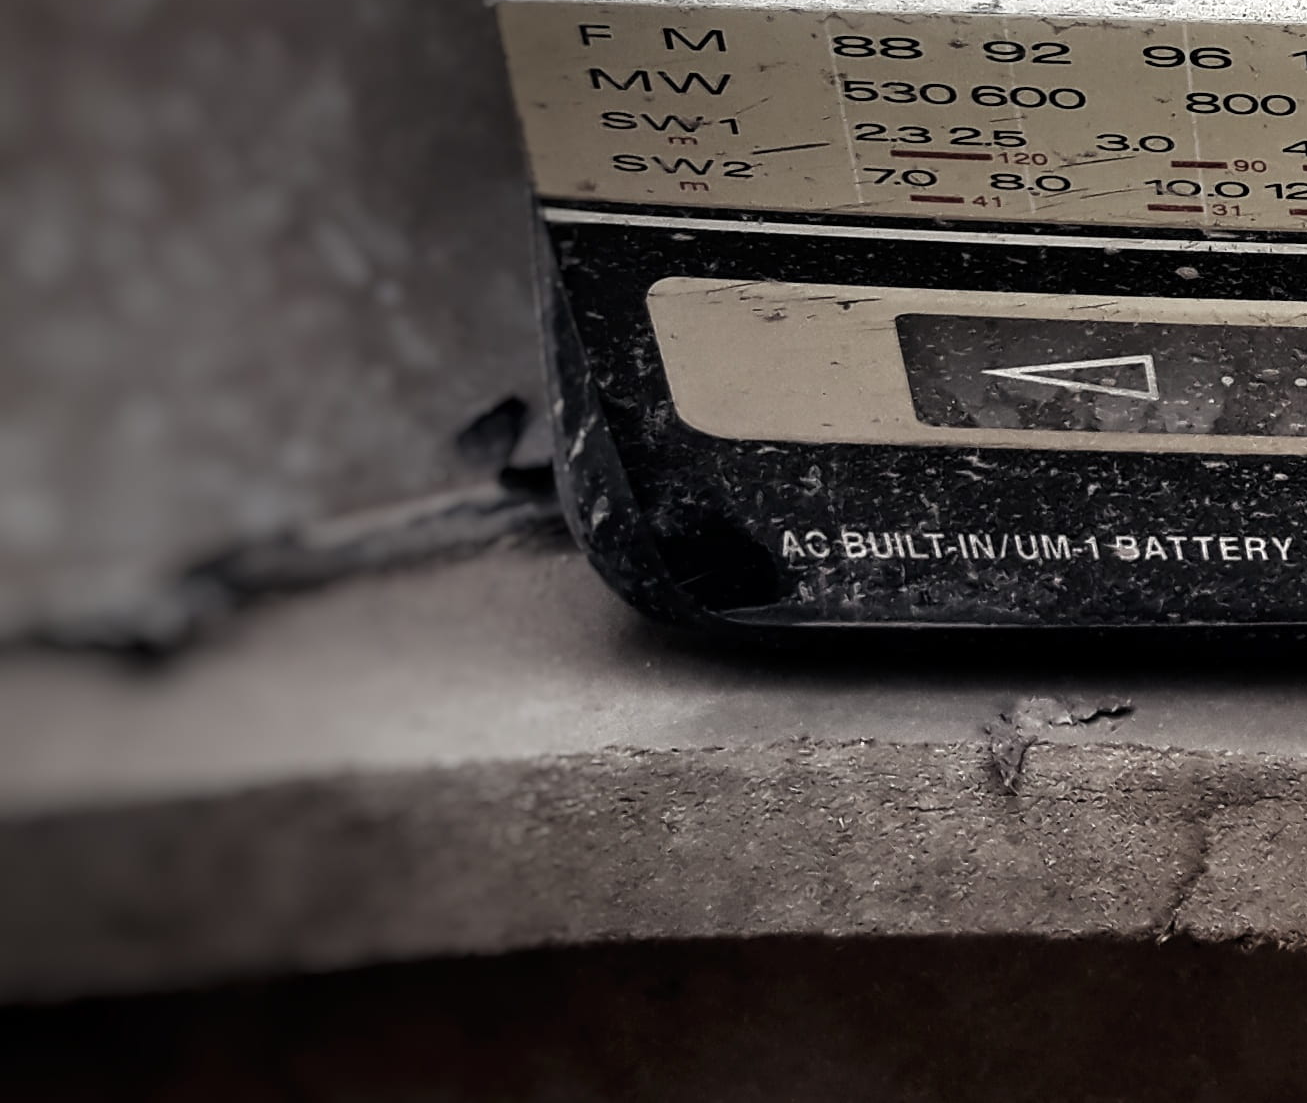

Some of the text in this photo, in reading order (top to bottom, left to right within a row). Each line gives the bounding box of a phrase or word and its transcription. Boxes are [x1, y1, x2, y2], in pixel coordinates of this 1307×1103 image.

[831, 35, 925, 60] 88
[983, 40, 1073, 66] 92
[1142, 46, 1233, 70] 96
[590, 68, 731, 95] MW
[842, 80, 957, 106] 530
[970, 86, 1086, 110] 600
[1186, 93, 1297, 115] 800
[668, 136, 698, 145] m
[1001, 152, 1048, 165] 120
[1233, 159, 1267, 173] 90
[854, 123, 932, 144] 2.3
[949, 127, 1027, 147] 2.5
[1096, 134, 1174, 153] 3.0
[612, 154, 753, 178] SW2
[863, 168, 938, 187] 7.0
[990, 173, 1071, 192] 8.0
[1144, 179, 1250, 197] 10.0
[680, 181, 709, 191] m
[972, 195, 1001, 208] 41
[1211, 203, 1240, 216] 31
[782, 531, 1294, 562] AC BUILT-IN/UM-1 BATTERY
